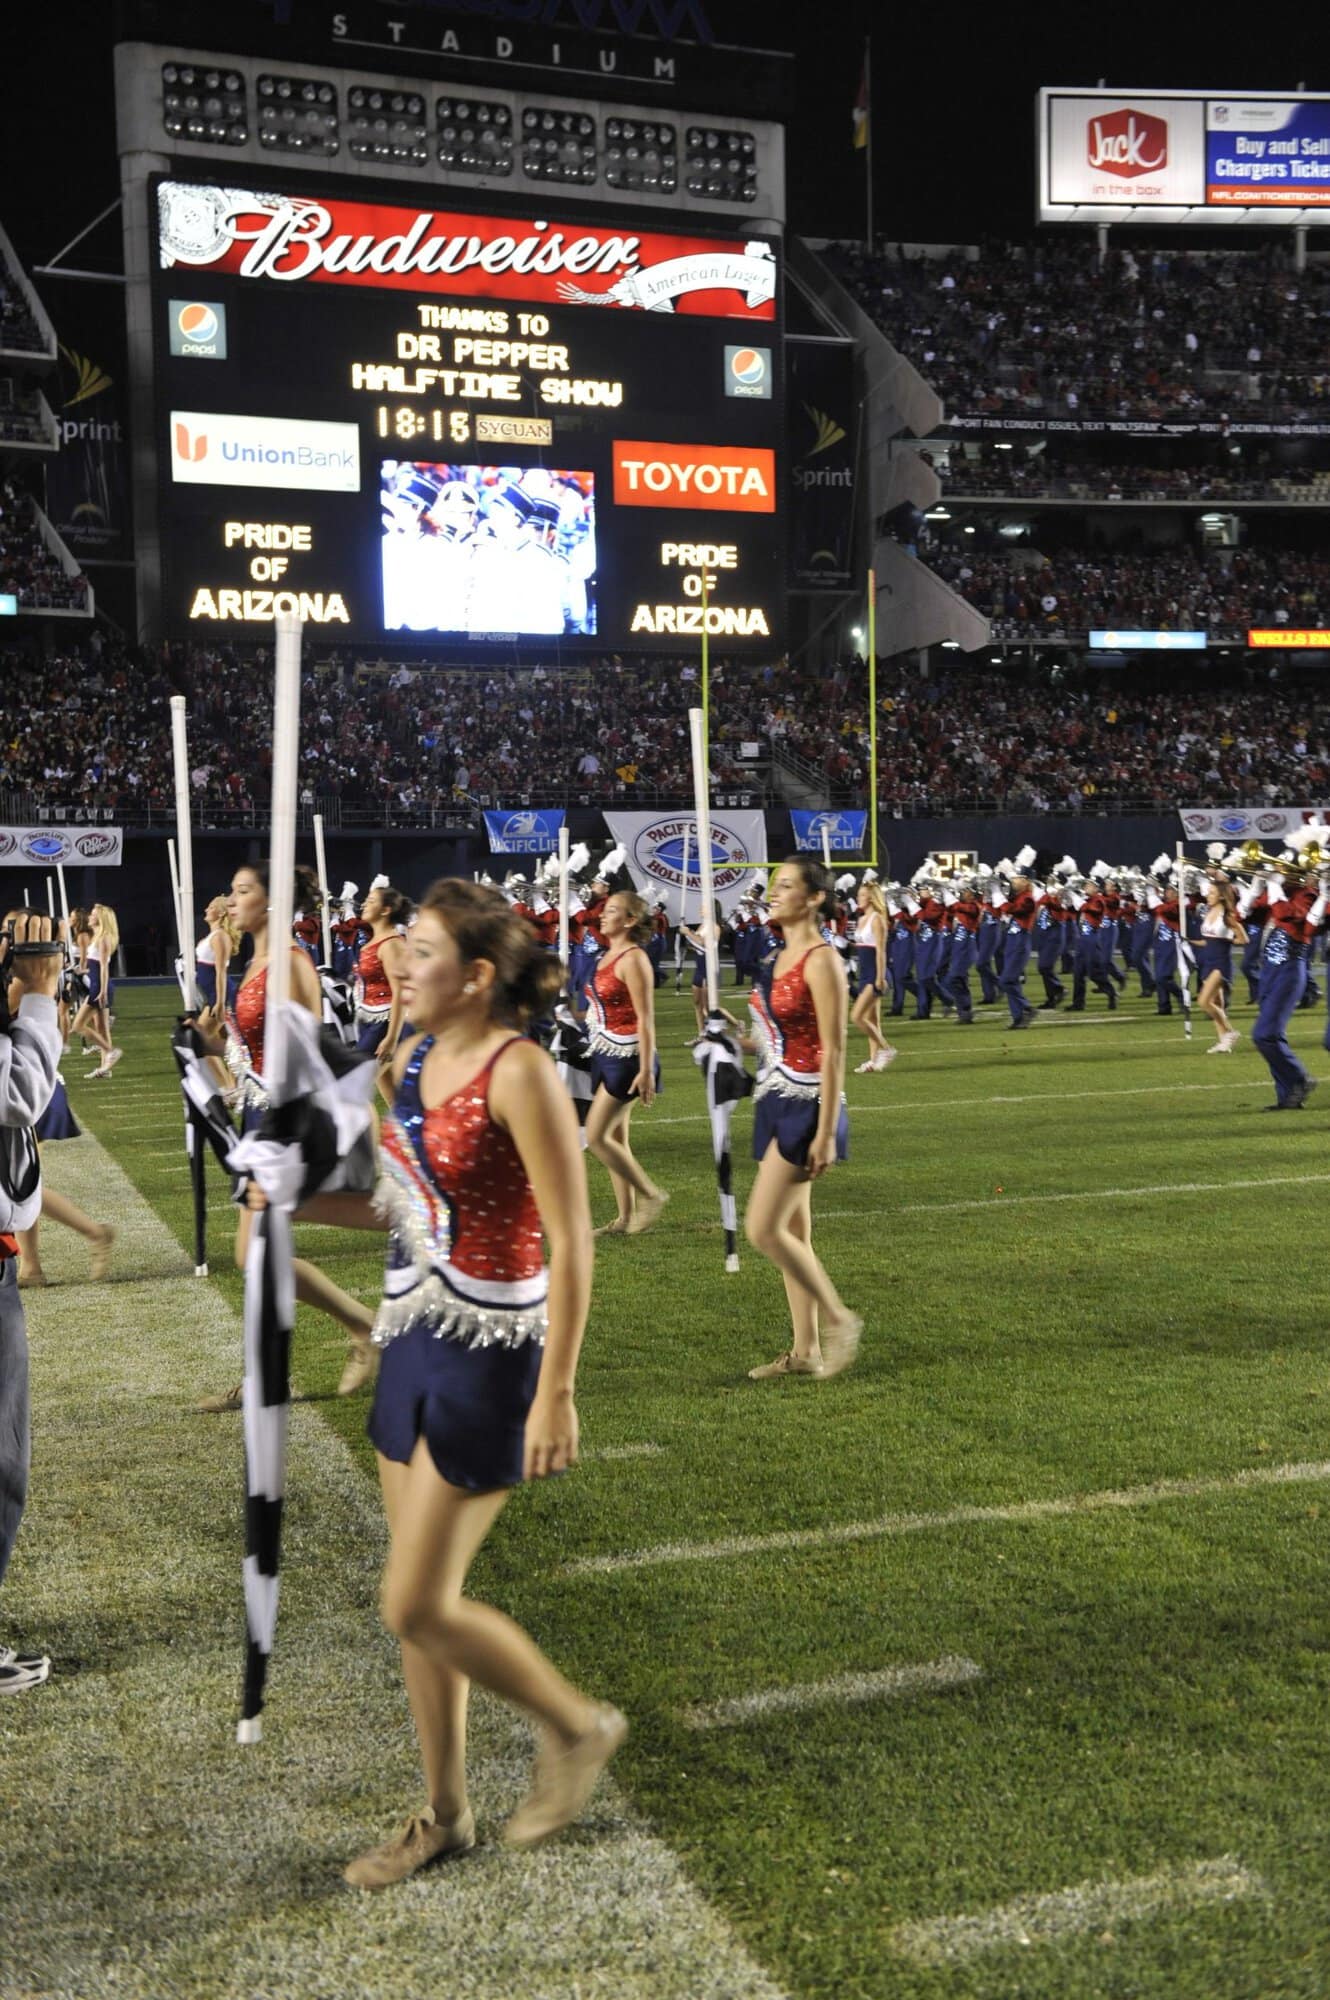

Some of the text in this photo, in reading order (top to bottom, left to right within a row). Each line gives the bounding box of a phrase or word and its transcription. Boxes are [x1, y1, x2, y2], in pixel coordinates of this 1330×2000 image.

[332, 15, 675, 79] STADIUM
[1089, 117, 1165, 168] Jack
[1236, 137, 1330, 158] Buy and Sell
[1215, 159, 1288, 181] Chargers
[1092, 184, 1162, 195] in the box
[224, 205, 642, 281] Budweiser
[647, 265, 769, 295] American Lager
[417, 304, 549, 336] THANKS TO
[182, 344, 216, 357] pepsi
[397, 333, 569, 371] DR PEPPER
[352, 363, 622, 407] HALFTIME SHOW
[734, 385, 763, 396] pepsi
[479, 420, 549, 438] SYCUAN
[222, 441, 355, 468] UnionBank
[621, 461, 768, 496] TOYOTA
[792, 466, 852, 491] Sprint
[225, 522, 312, 550] PRIDE
[250, 556, 288, 581] OF
[661, 543, 737, 568] PRIDE
[189, 588, 350, 623] ARIZONA
[630, 604, 770, 636] ARIZONA
[1252, 631, 1307, 646] WELLS
[539, 837, 559, 852] LIF
[646, 823, 698, 843] PACIFC
